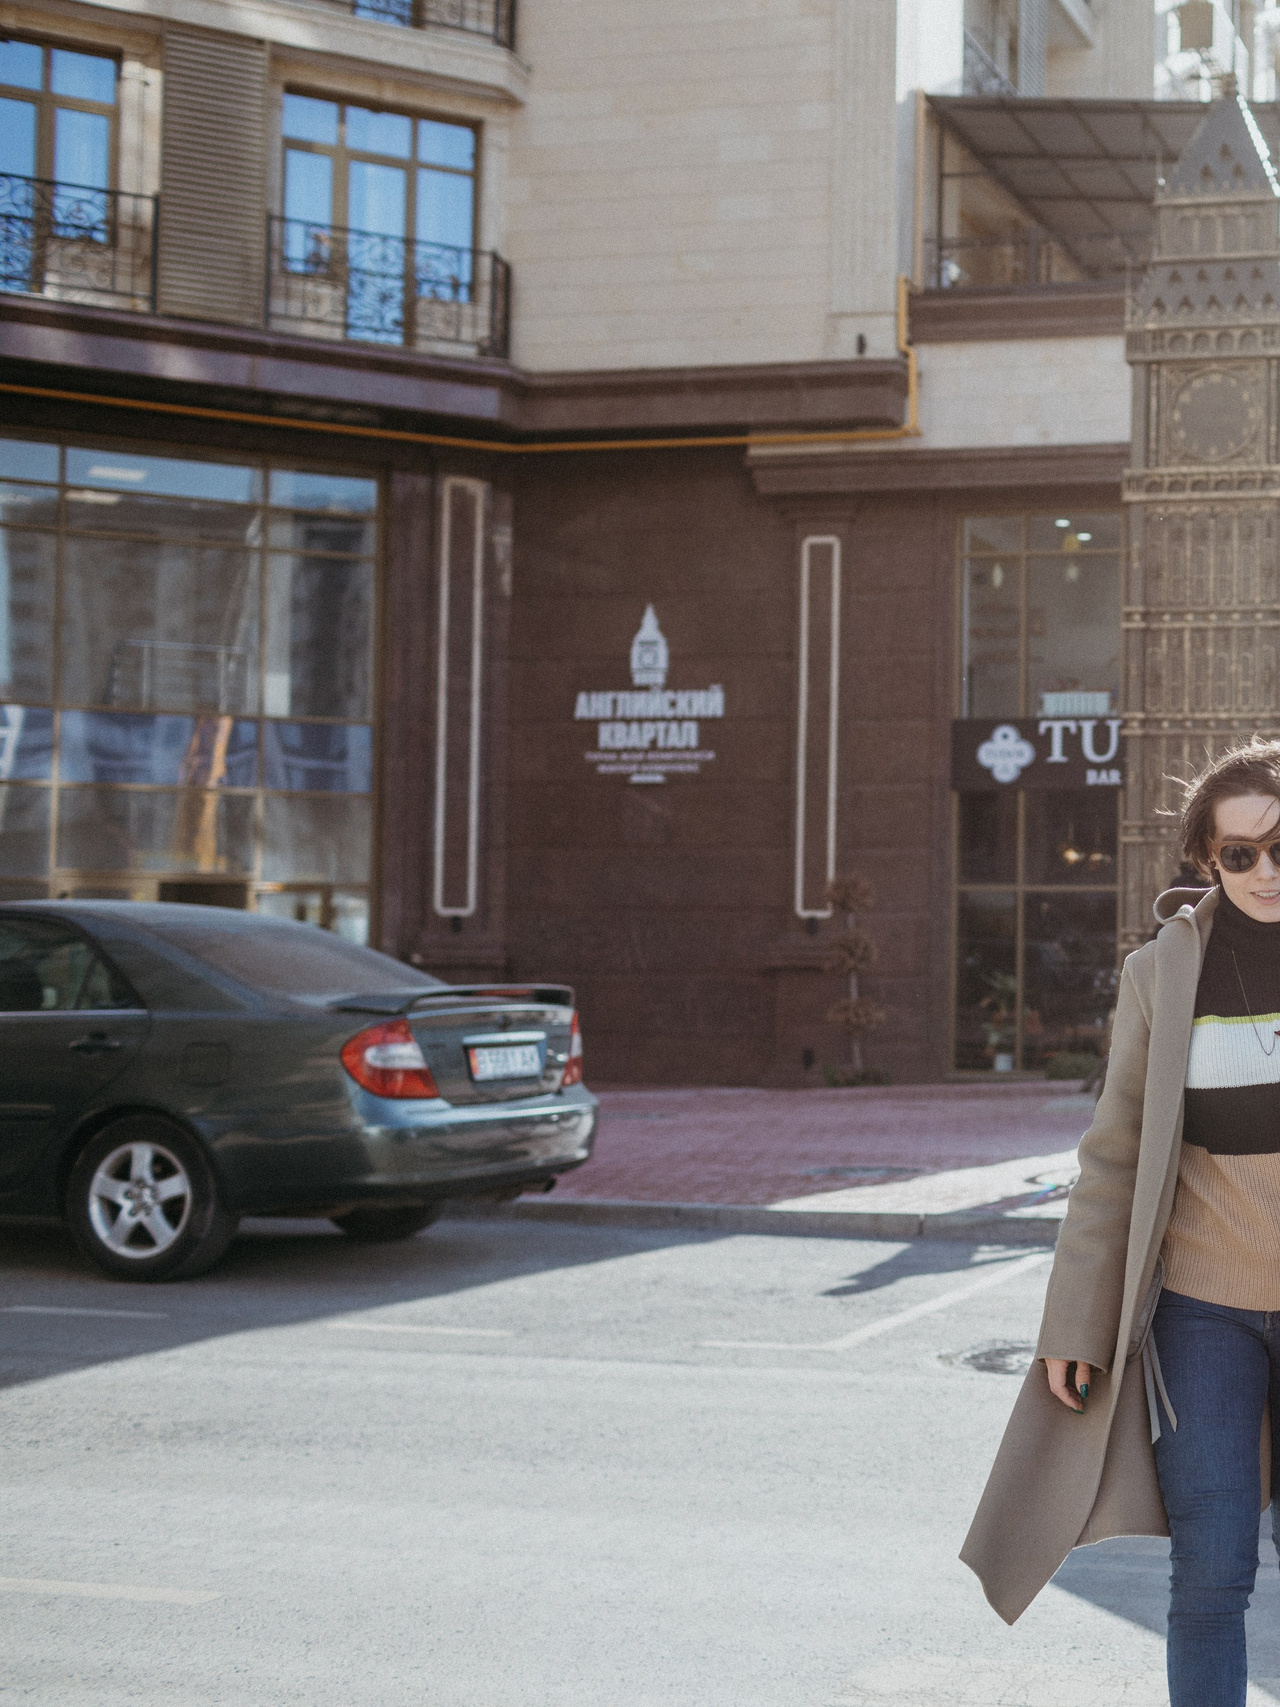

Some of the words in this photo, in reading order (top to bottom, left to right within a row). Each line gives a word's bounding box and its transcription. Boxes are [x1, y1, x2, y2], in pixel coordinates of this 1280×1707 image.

[574, 684, 725, 719] АНГЛИЙСКИЙ
[598, 720, 698, 749] КВАРТАЛ
[1039, 720, 1123, 763] TU
[1086, 769, 1122, 785] BAR
